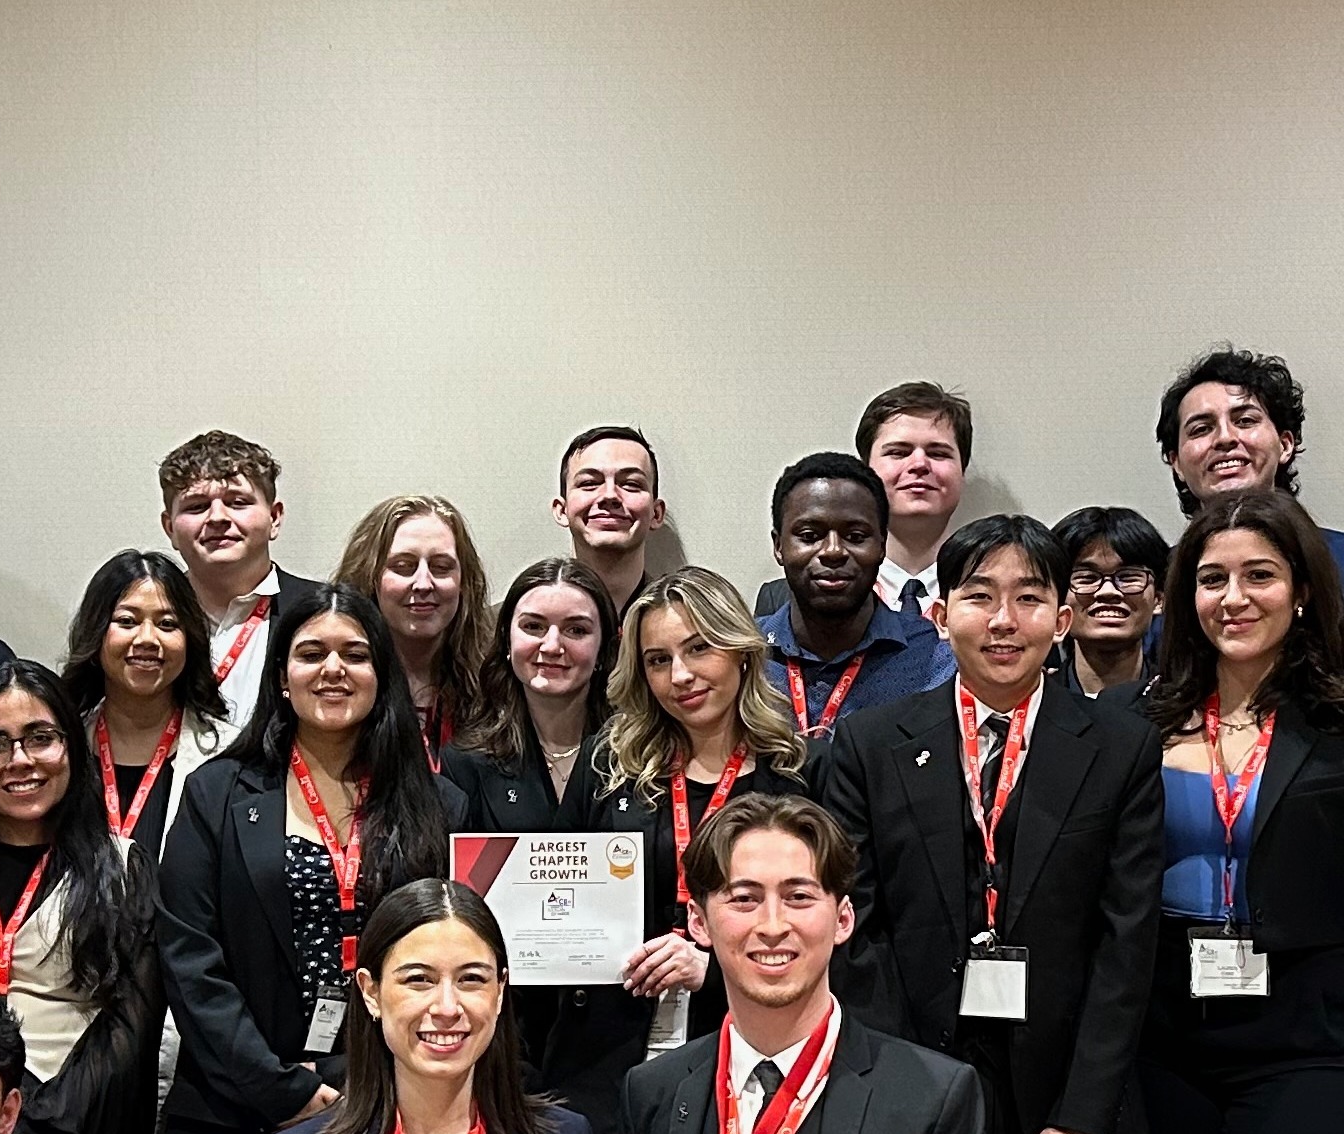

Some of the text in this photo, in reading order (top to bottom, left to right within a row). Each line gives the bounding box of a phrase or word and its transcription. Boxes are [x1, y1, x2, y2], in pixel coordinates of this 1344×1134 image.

[235, 616, 263, 648] Canada
[791, 664, 805, 700] Canada
[831, 675, 853, 707] Canada
[964, 705, 978, 741] Canada
[1009, 709, 1027, 743] Canada
[150, 746, 167, 775] Canada
[300, 775, 319, 804] Canada
[719, 767, 737, 796] Canada
[129, 786, 148, 815] Canada
[1228, 784, 1248, 816] Canada
[317, 814, 336, 843] Canada
[674, 802, 690, 830] Canada
[529, 856, 589, 866] CHAPTER
[530, 842, 587, 852] LARGEST
[529, 870, 588, 880] GROWTH
[0, 933, 14, 968] Canada
